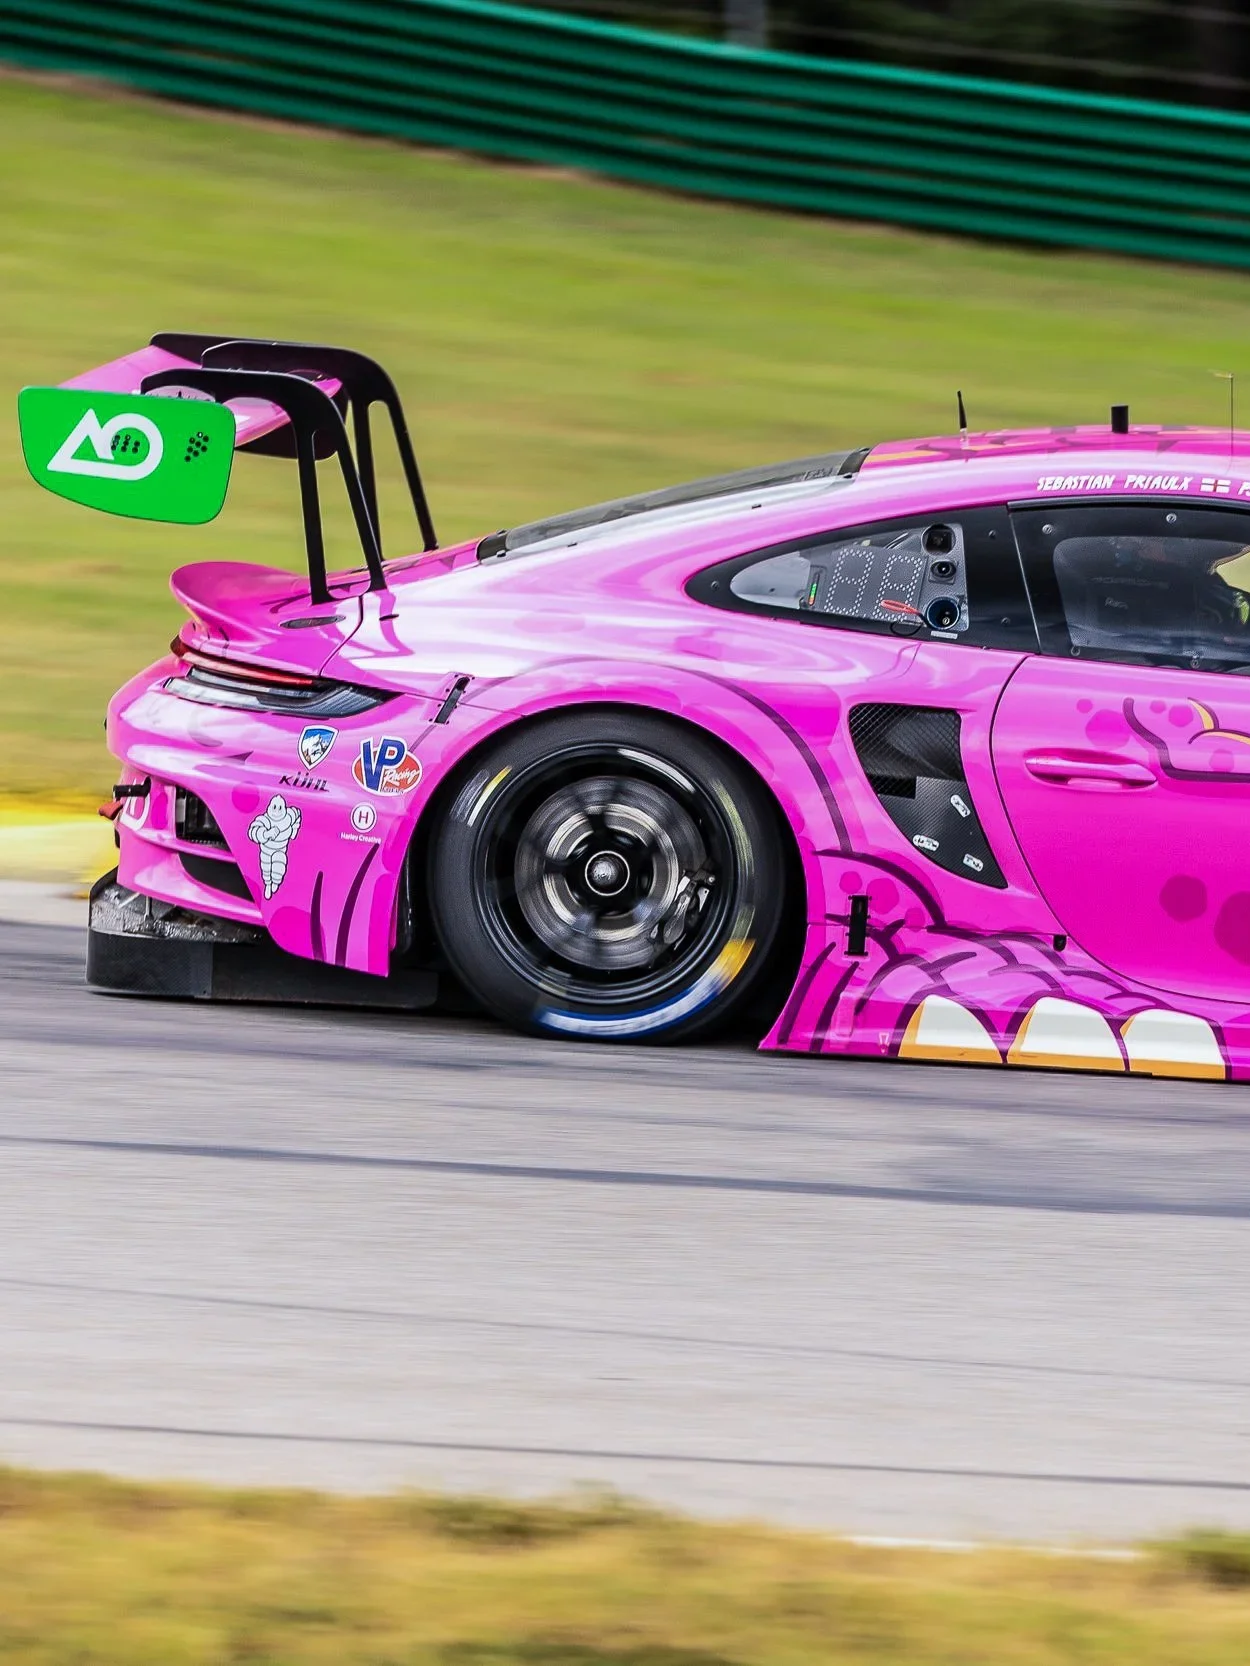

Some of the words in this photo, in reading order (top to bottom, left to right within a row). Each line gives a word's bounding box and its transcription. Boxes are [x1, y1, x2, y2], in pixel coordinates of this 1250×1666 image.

[1037, 474, 1115, 491] SEBASTIAN
[1123, 475, 1193, 490] PRIAULX
[362, 737, 406, 792] VP
[382, 768, 420, 788] Racing
[340, 832, 358, 842] Harley
[358, 834, 382, 844] Creative
